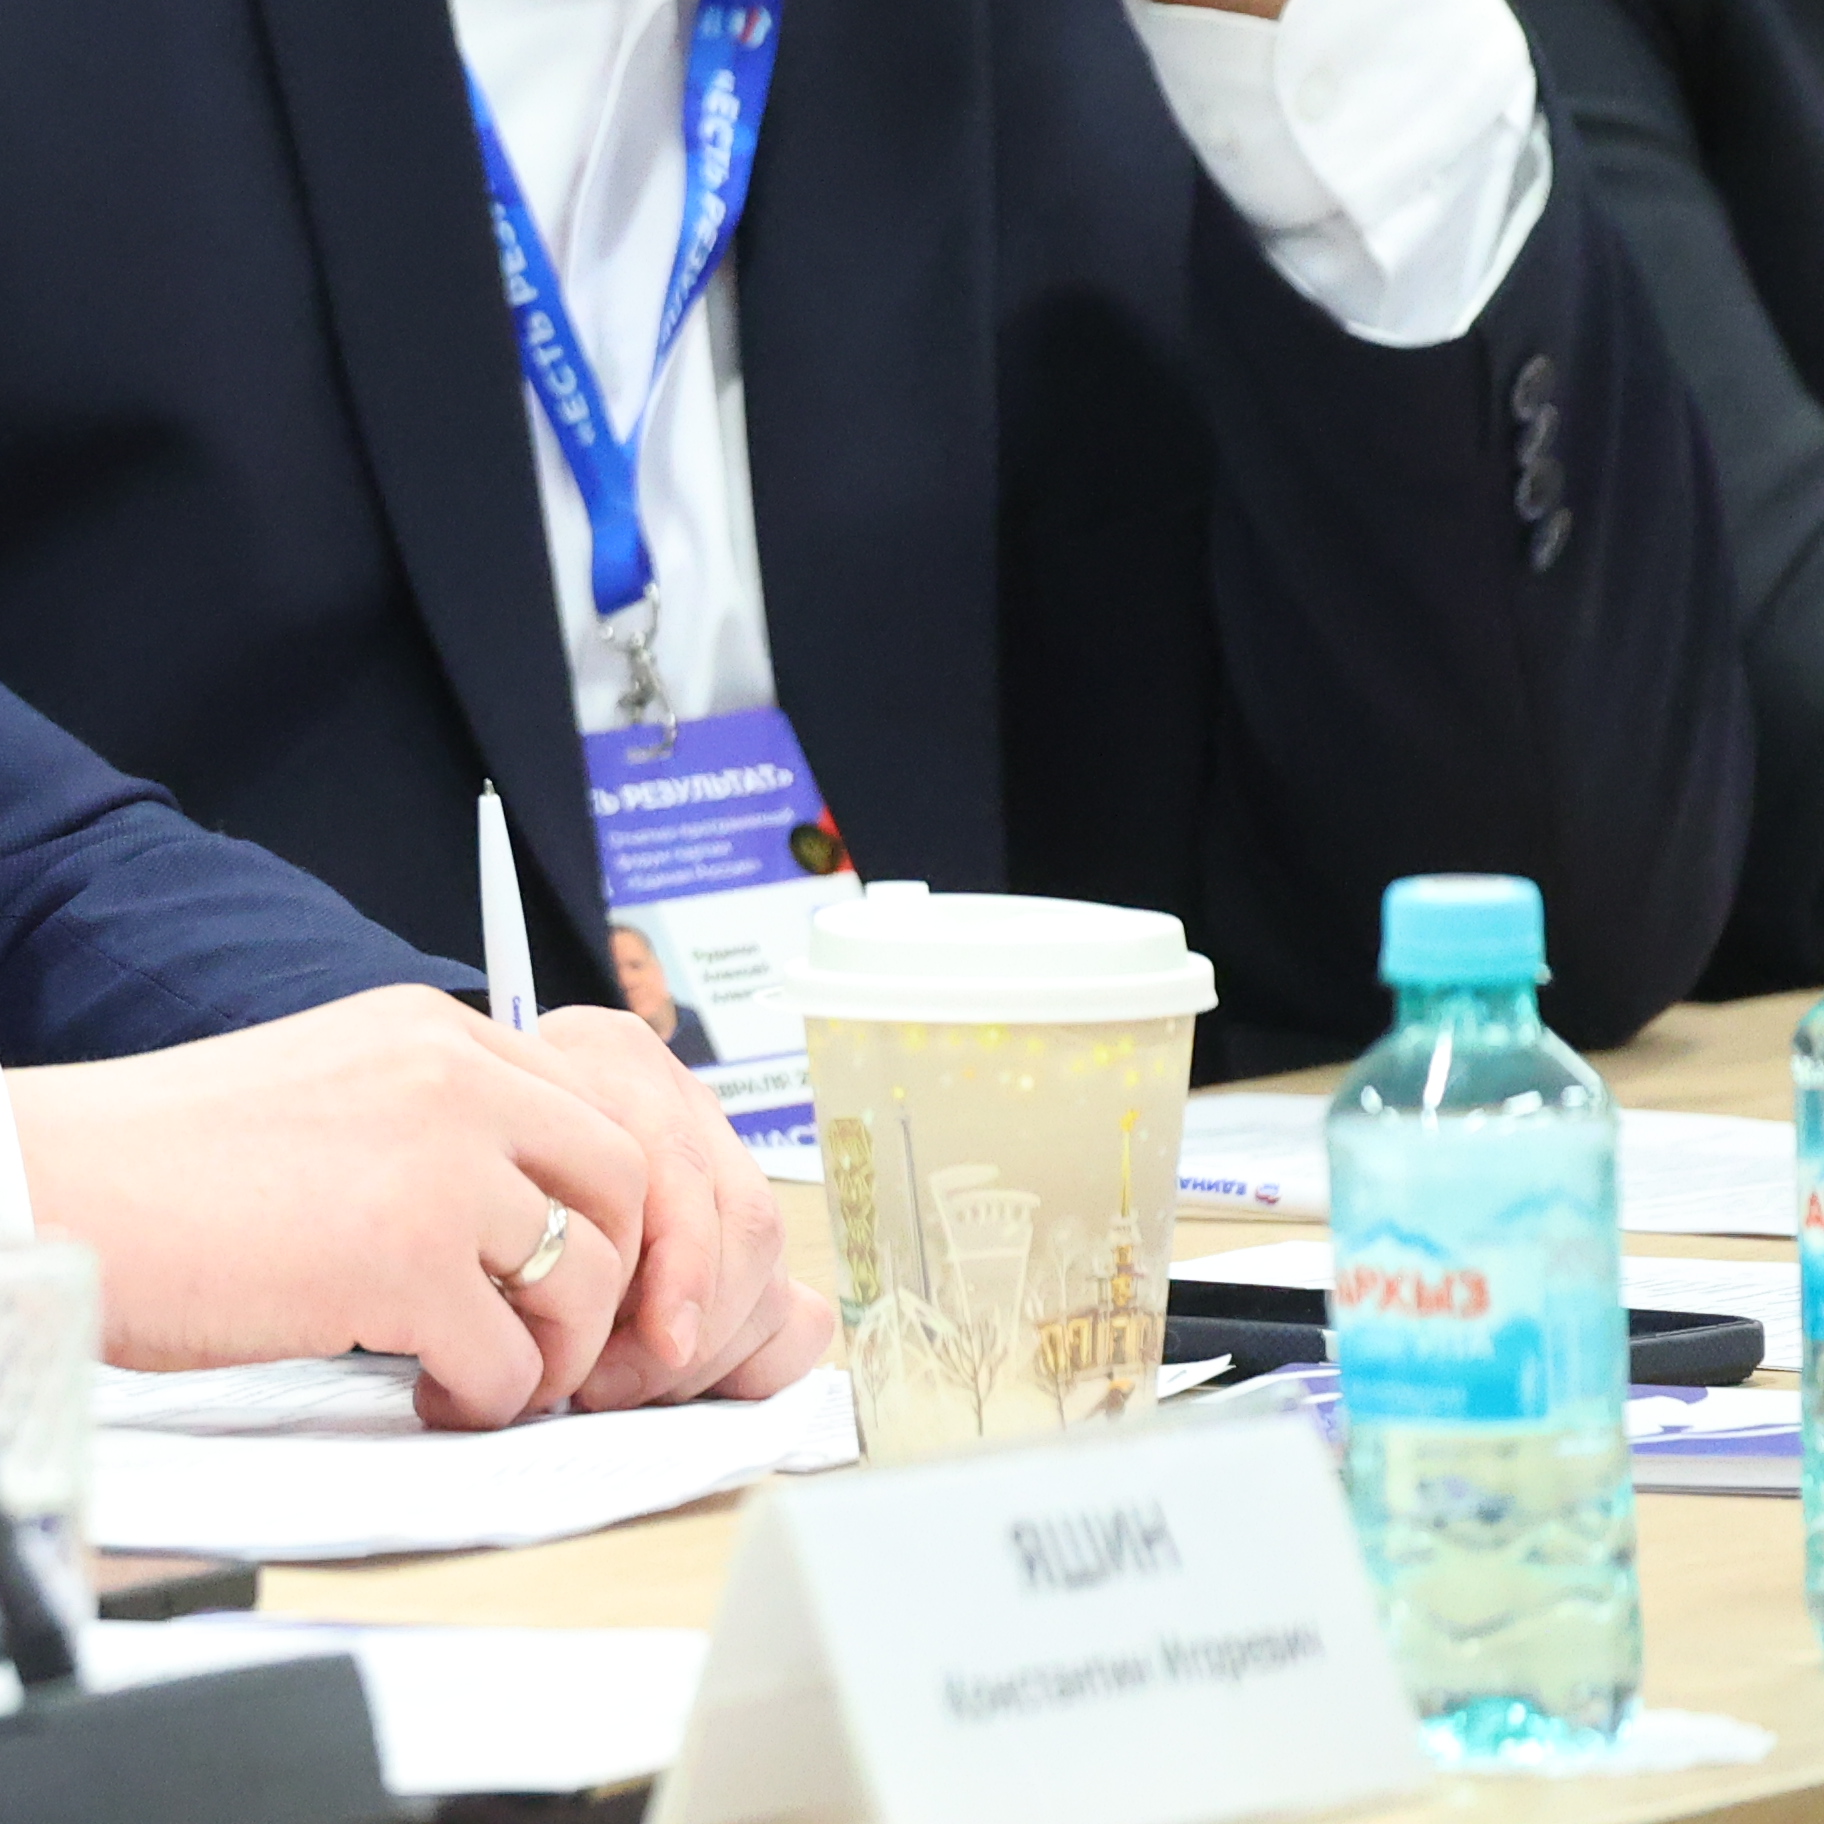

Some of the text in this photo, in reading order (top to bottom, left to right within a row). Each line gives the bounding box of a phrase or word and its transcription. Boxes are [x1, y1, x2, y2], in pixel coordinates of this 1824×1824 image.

[620, 762, 794, 812] РЕЗУЛЬТАТ»
[1179, 1177, 1247, 1196] ЕДИНА
[1007, 1500, 1184, 1593] ЯШИН
